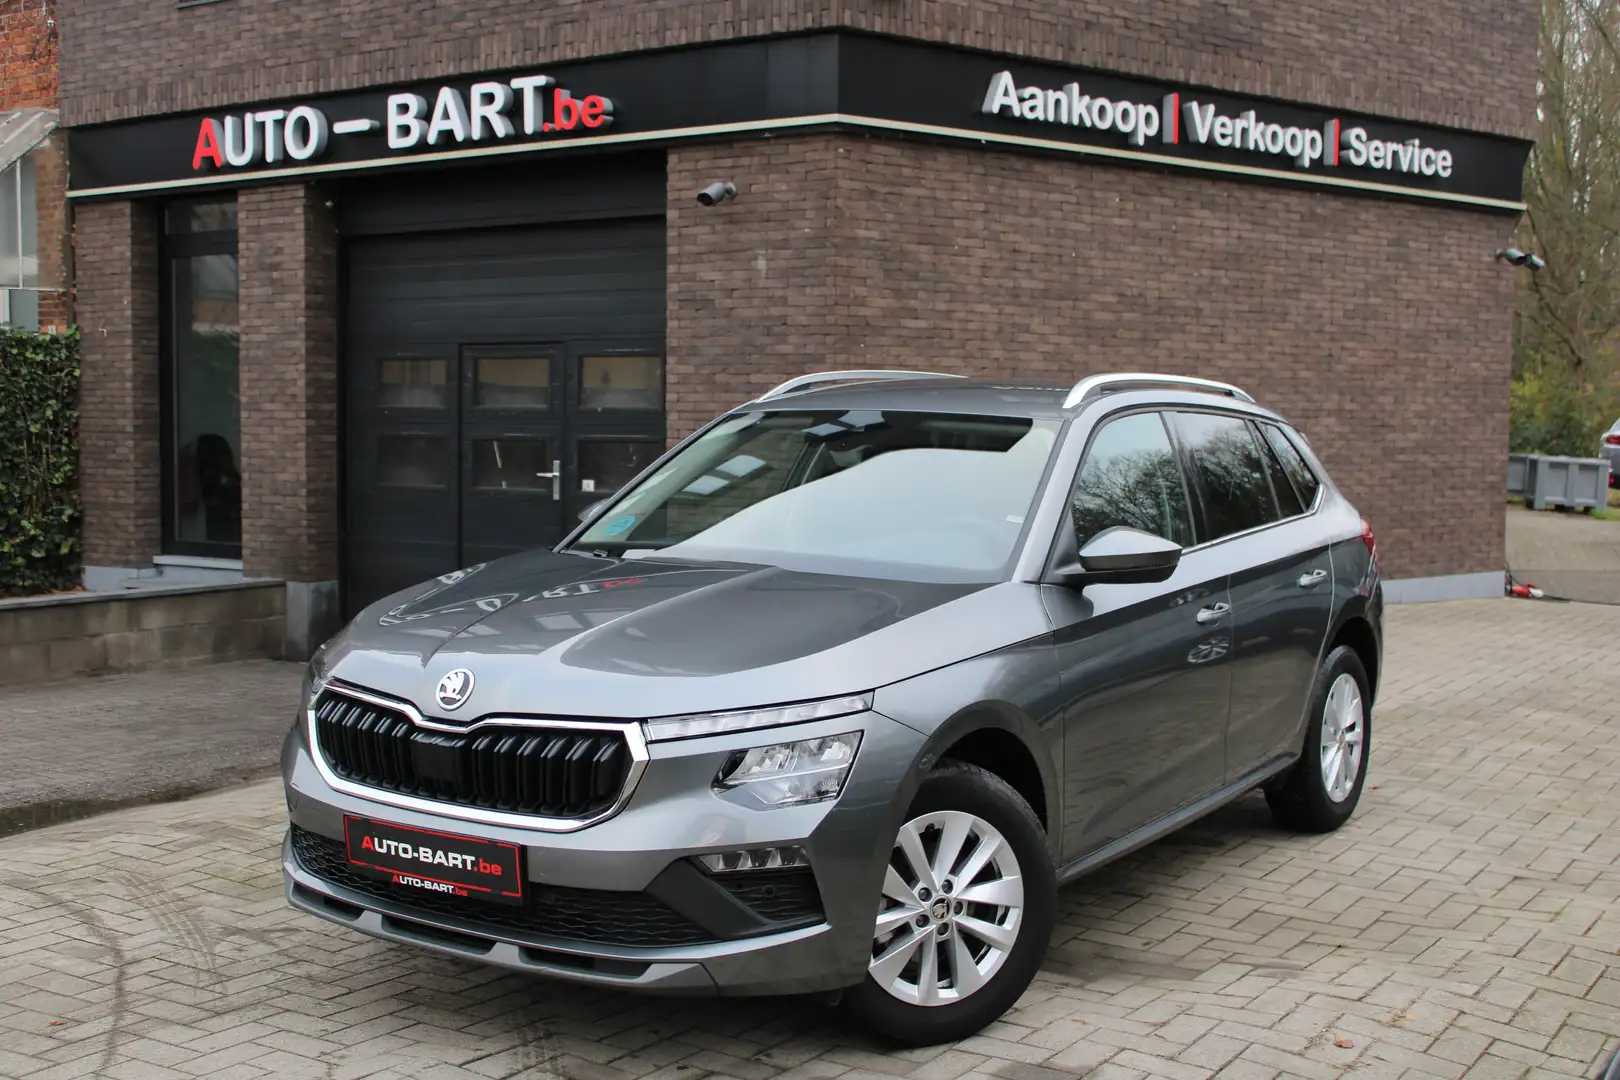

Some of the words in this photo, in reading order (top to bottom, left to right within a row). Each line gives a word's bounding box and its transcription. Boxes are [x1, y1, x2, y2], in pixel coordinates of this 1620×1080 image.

[987, 70, 1160, 146] Aankoop
[1186, 101, 1322, 168] Verkoop
[1347, 127, 1453, 178] Service
[361, 836, 503, 876] AUTO-BART.be
[392, 874, 469, 897] AUTO-BART.be
